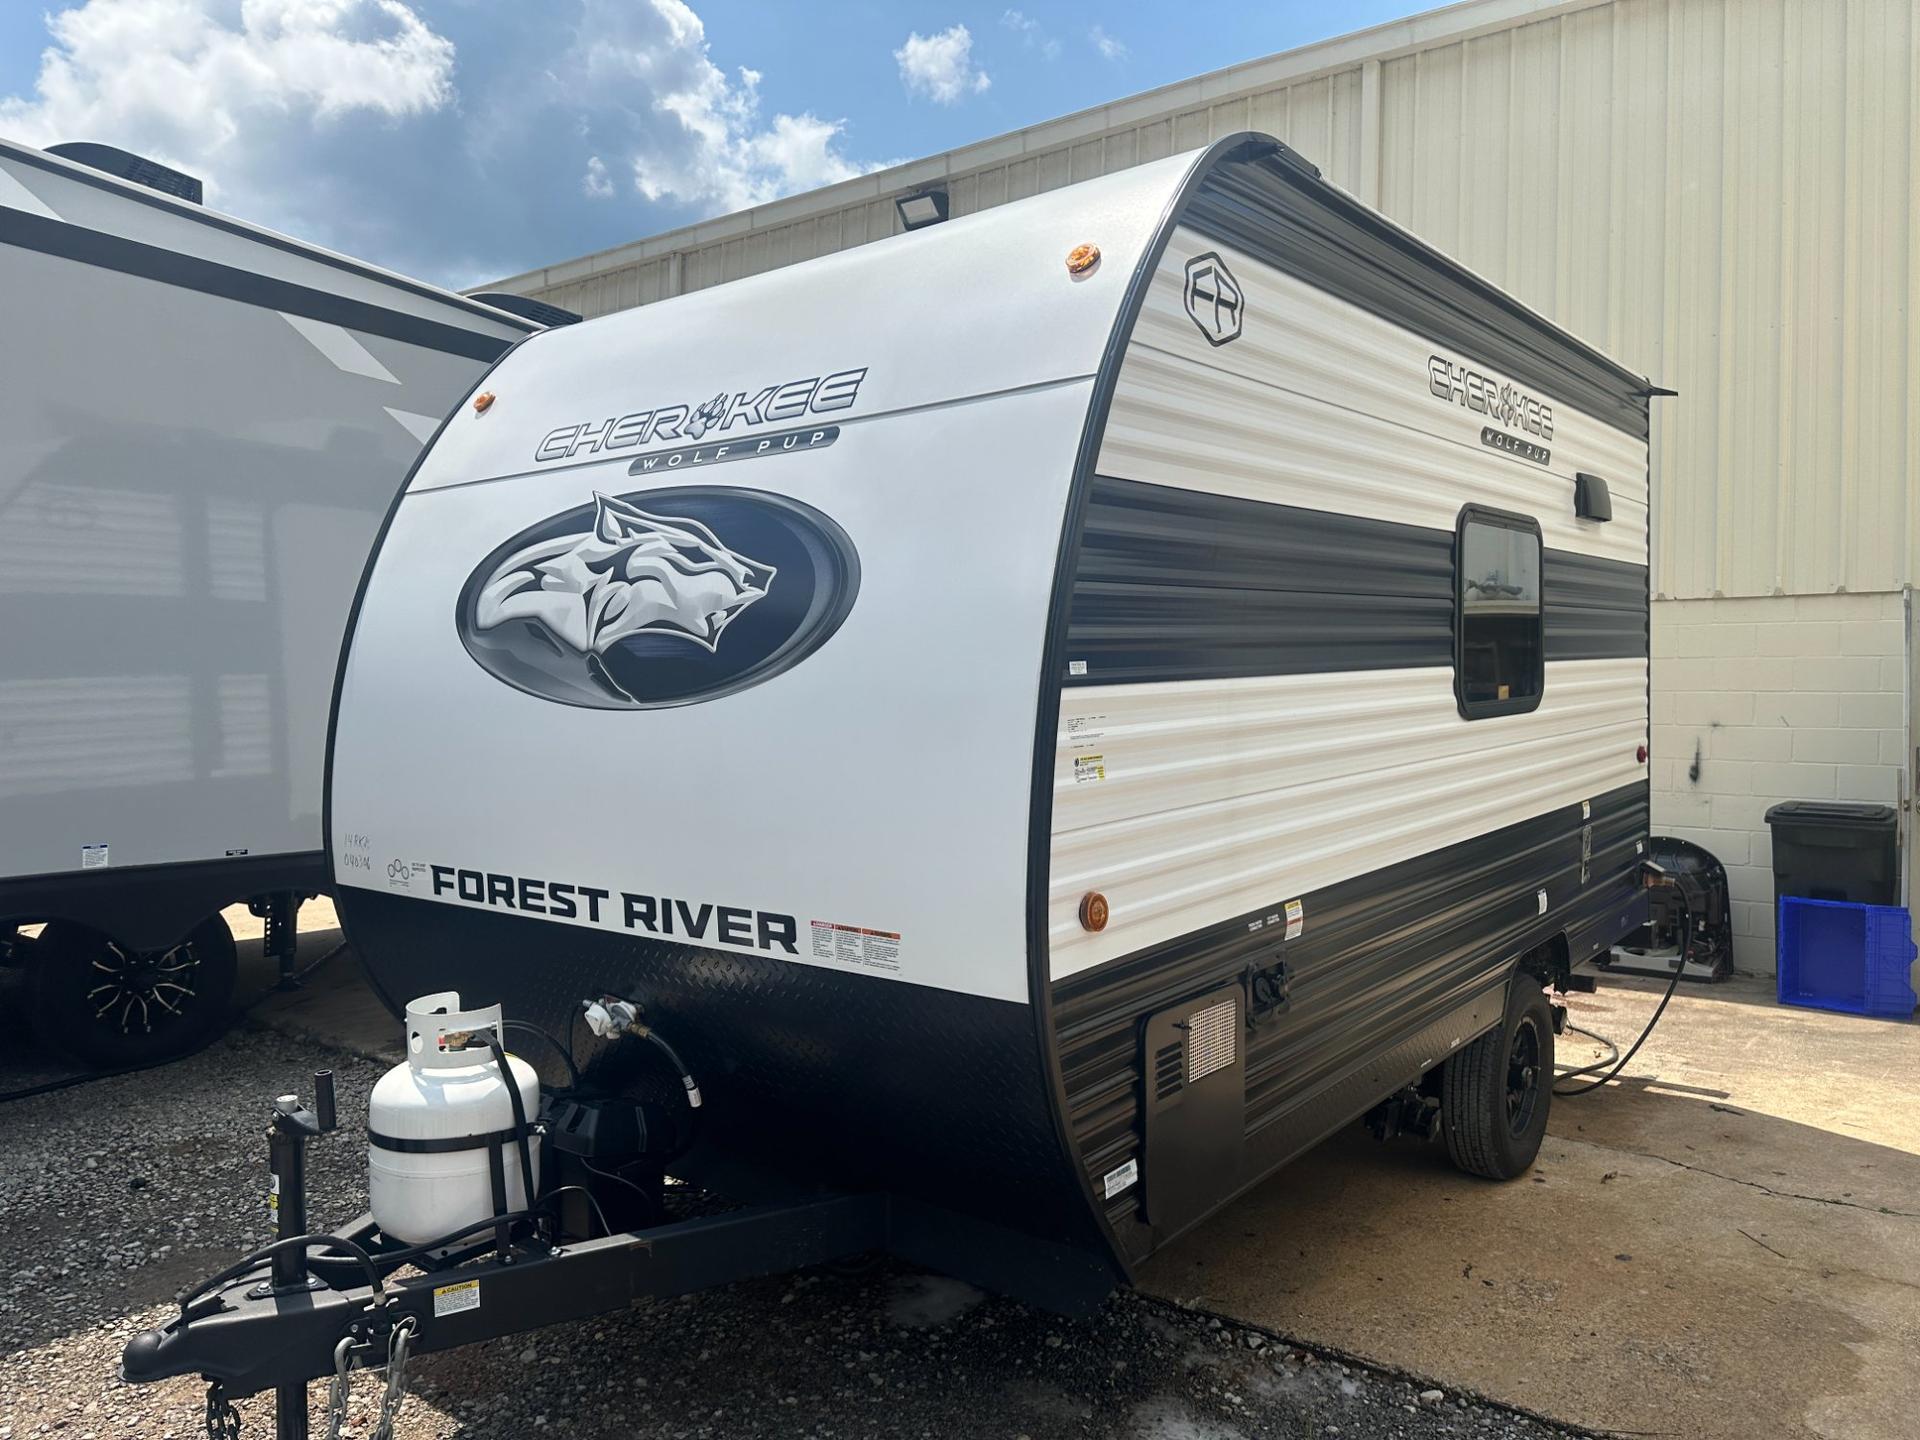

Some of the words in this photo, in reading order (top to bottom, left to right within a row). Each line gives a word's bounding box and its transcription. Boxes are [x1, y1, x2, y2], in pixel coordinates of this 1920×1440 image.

[642, 446, 730, 470] WOLF
[756, 430, 826, 454] PUP
[1486, 430, 1520, 451] WOLF
[1526, 445, 1547, 461] PUP
[430, 864, 610, 923] FOREST
[620, 892, 800, 955] RIVER
